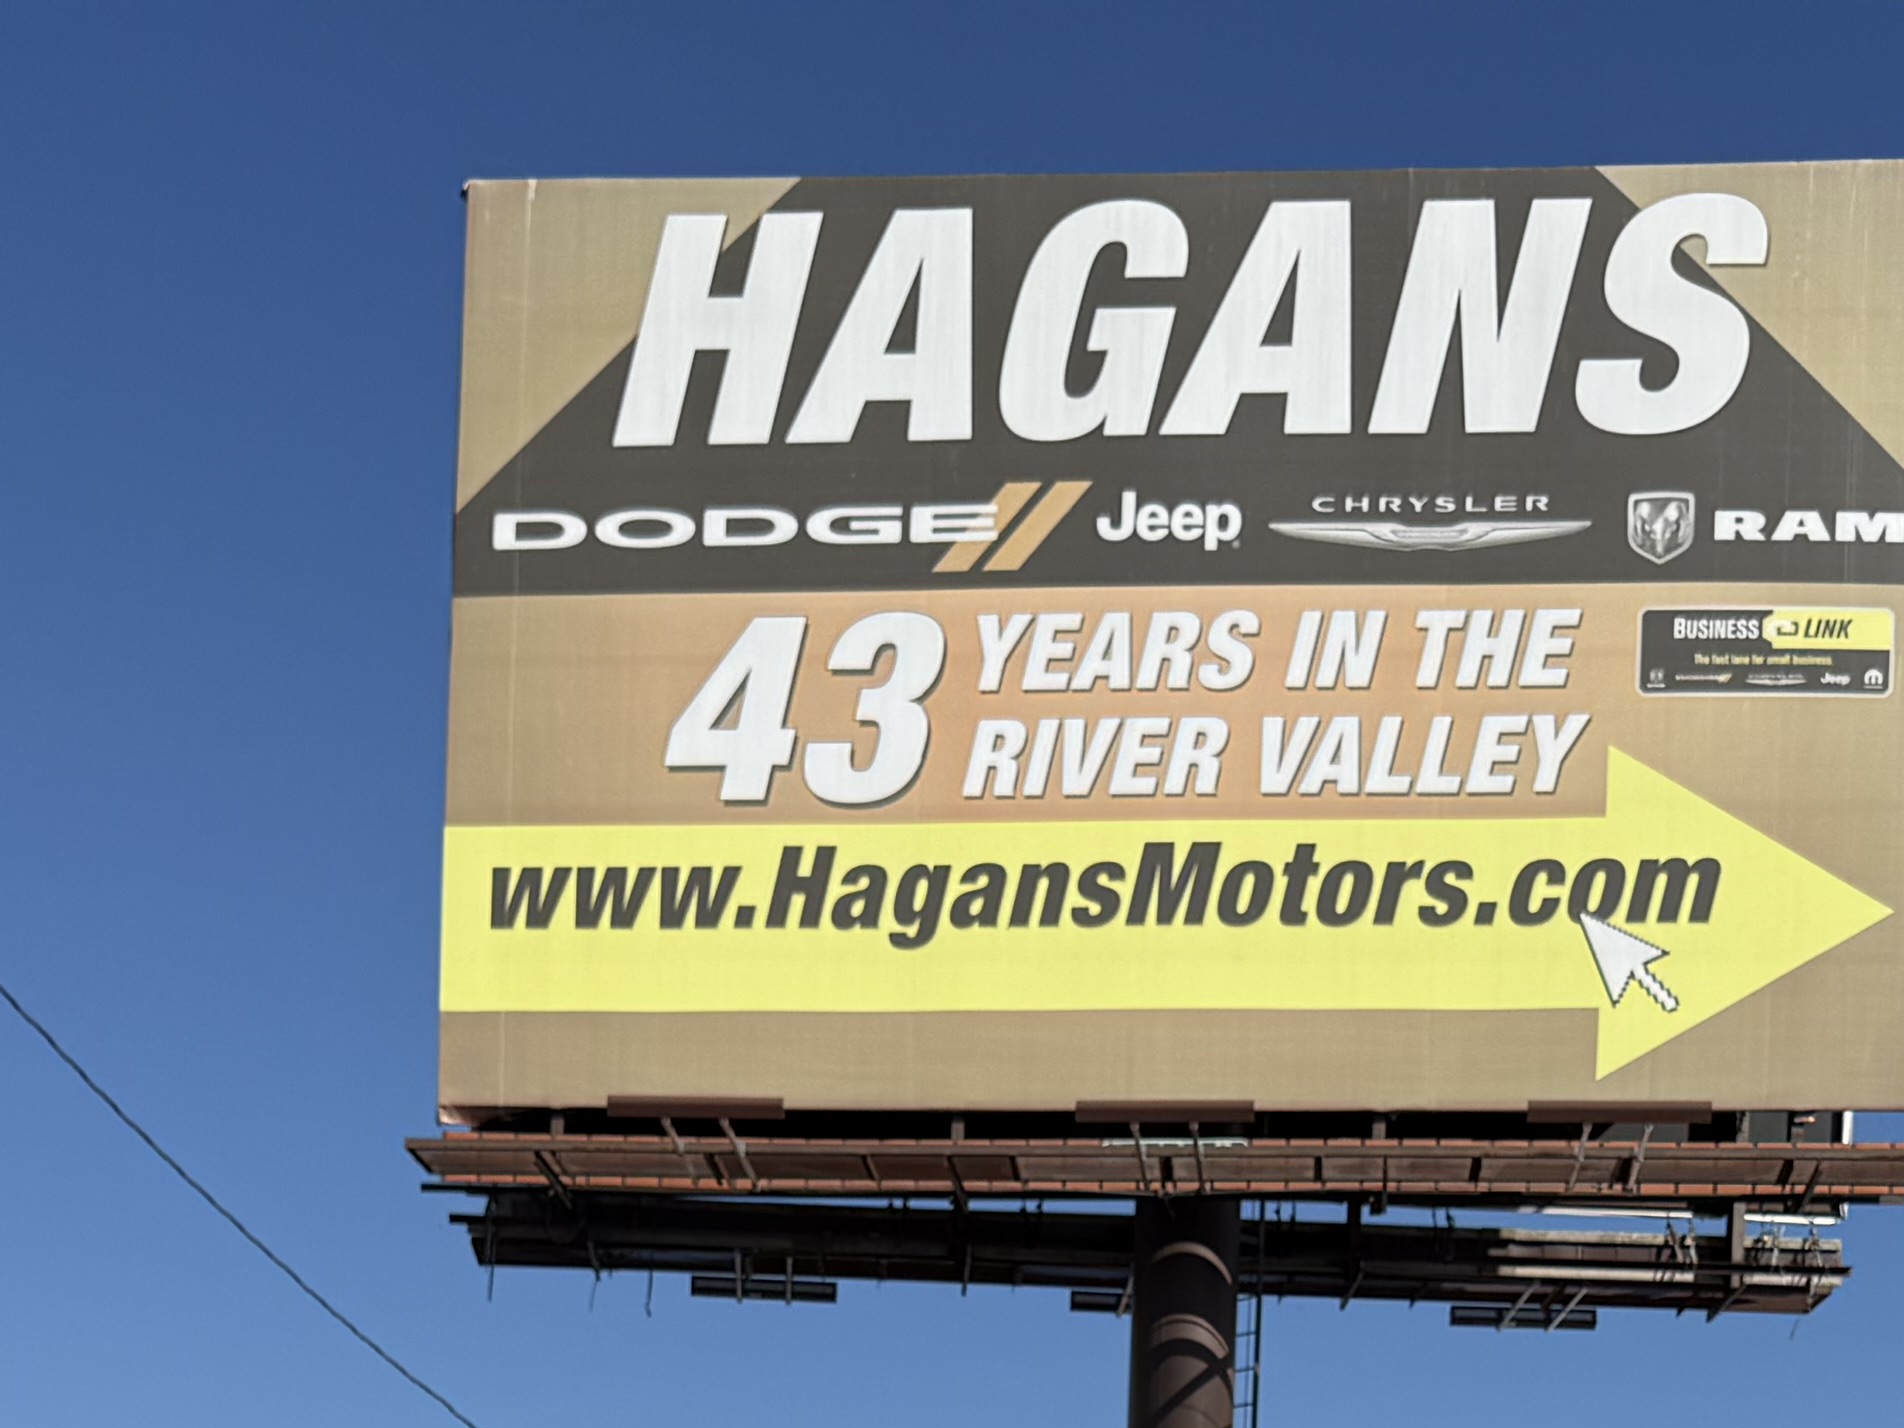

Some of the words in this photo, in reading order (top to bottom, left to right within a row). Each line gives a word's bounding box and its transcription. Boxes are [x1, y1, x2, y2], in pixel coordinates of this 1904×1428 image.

[612, 192, 1771, 447] HAGANS
[492, 503, 998, 551] DODGE
[1096, 490, 1243, 552] Jeep
[1312, 493, 1550, 514] CHRYSLER
[977, 610, 1261, 693] YEARS
[1285, 610, 1387, 689] IN
[1415, 608, 1583, 689] THE
[1673, 616, 1760, 640] BUSINESS
[1803, 618, 1853, 640] LINK
[664, 611, 946, 808] 43
[963, 716, 1229, 799] RIVER
[1260, 714, 1591, 796] VALLEY
[489, 841, 1722, 950] www.HagansMotors.com
